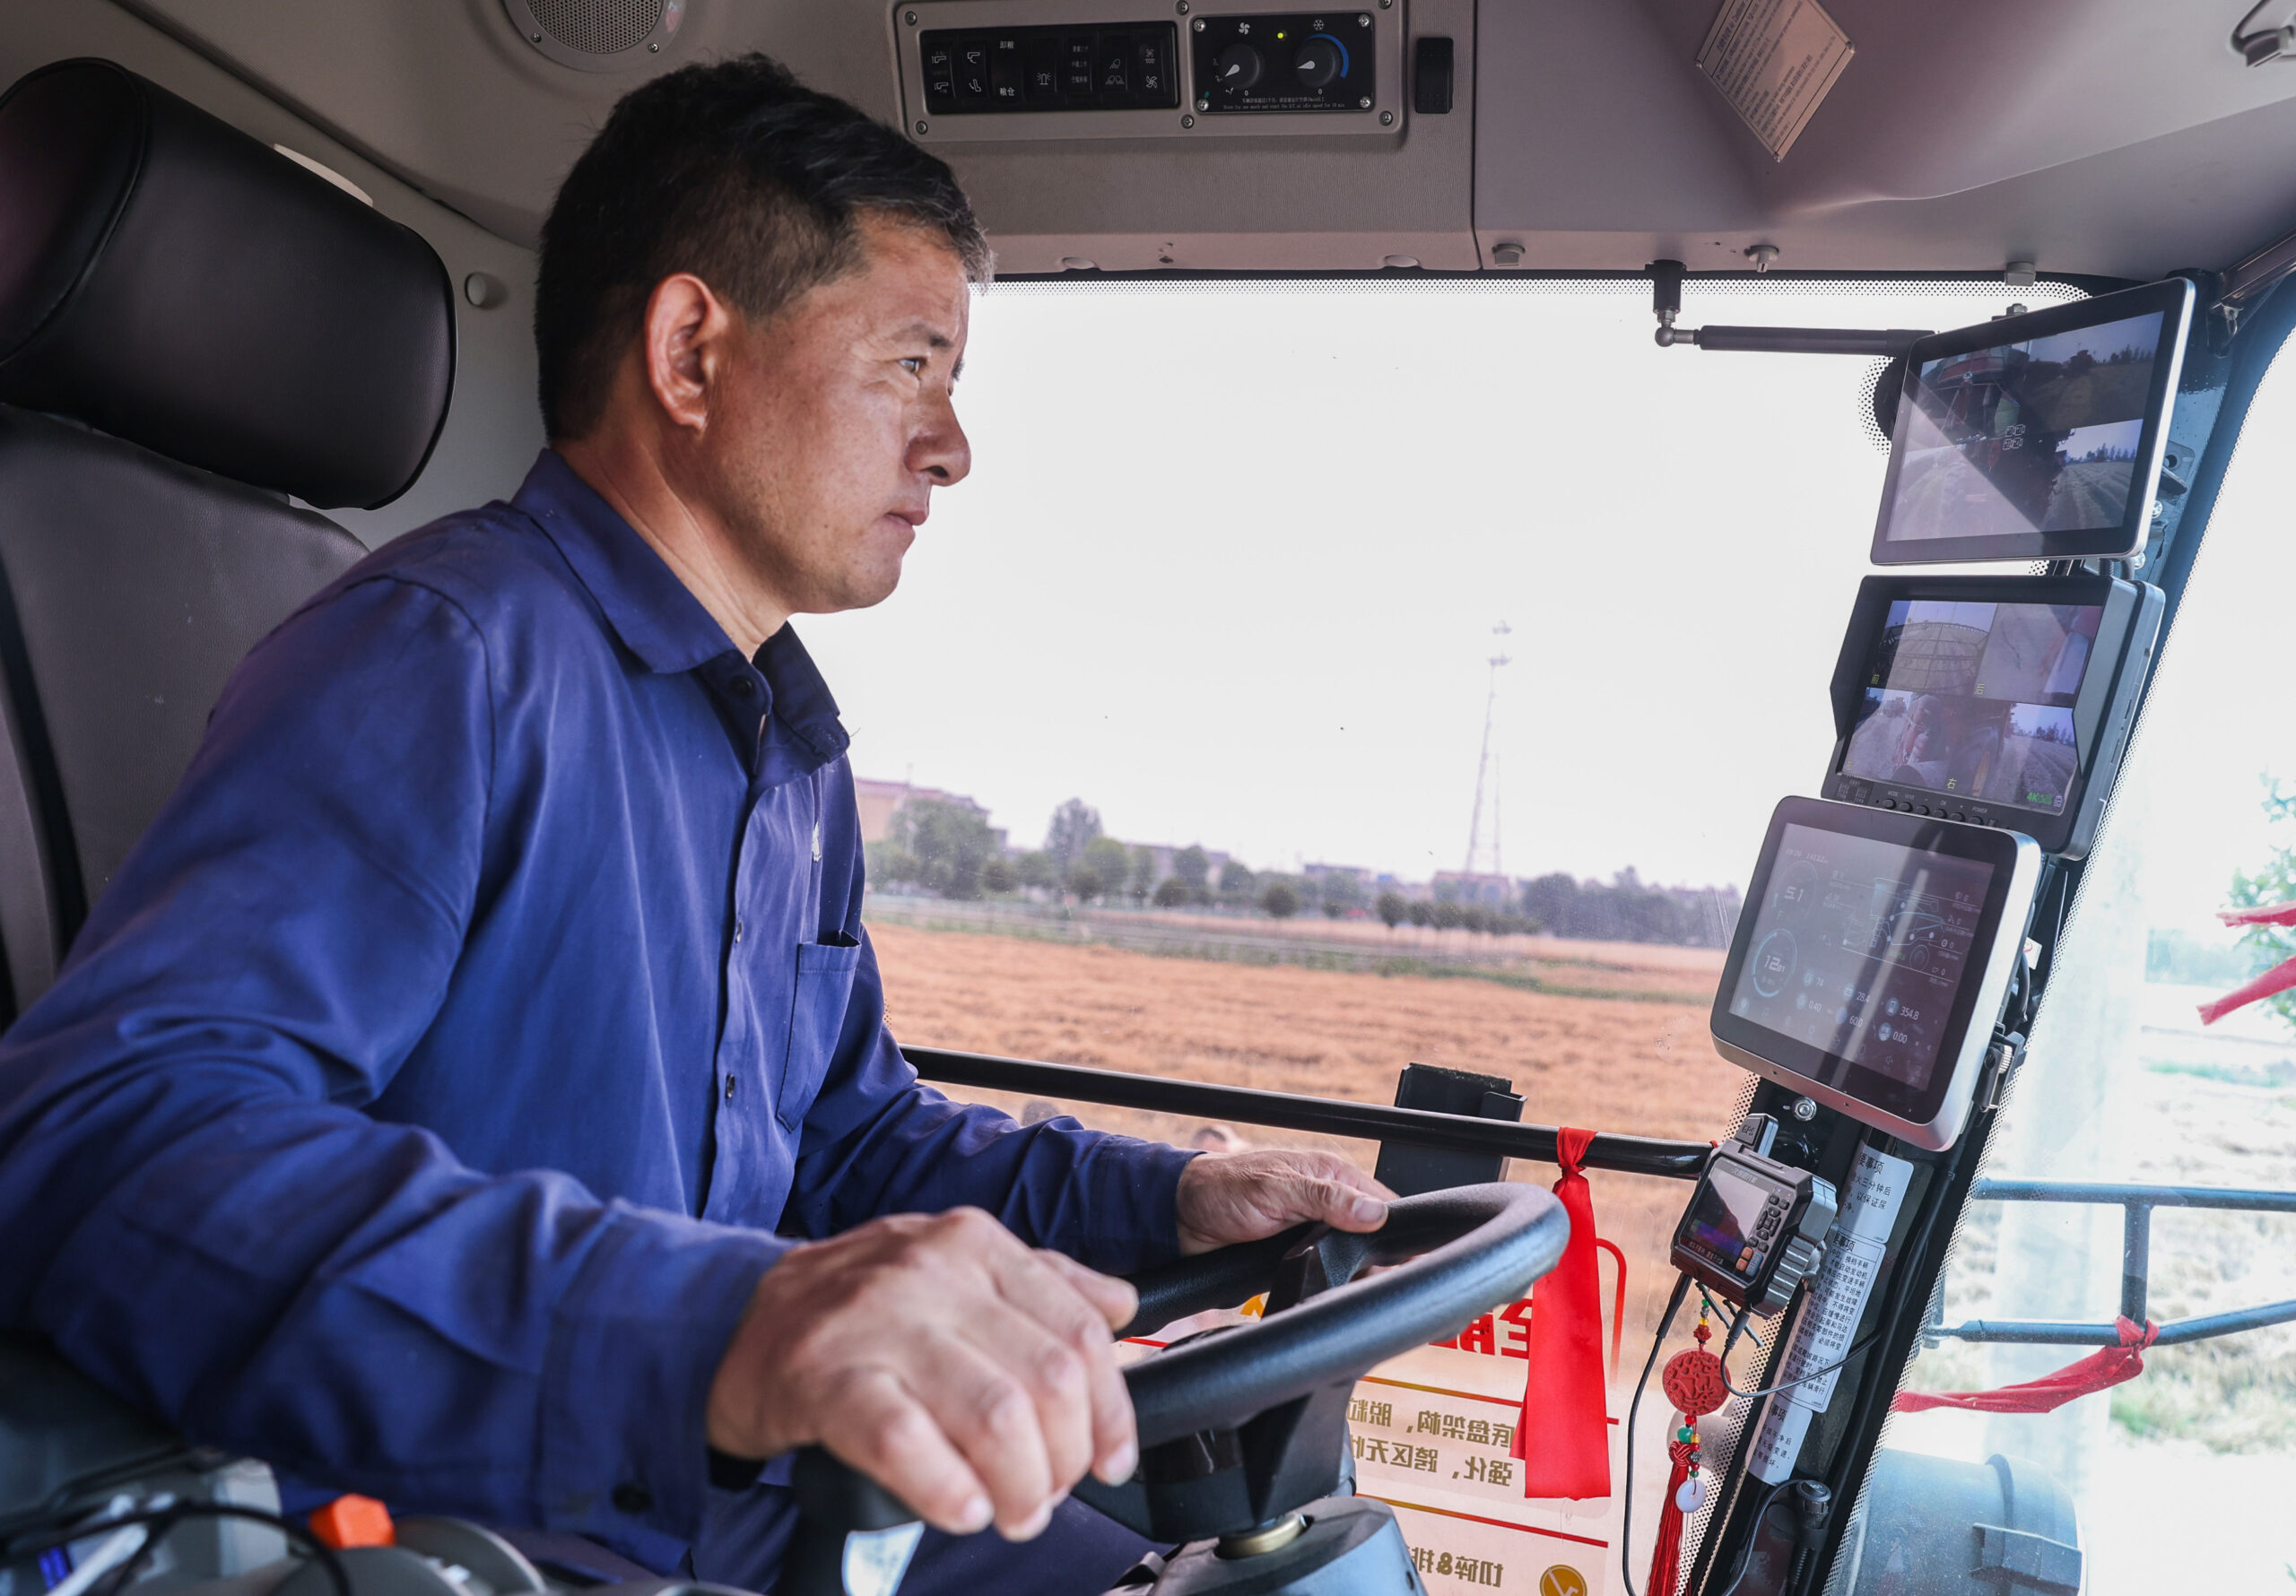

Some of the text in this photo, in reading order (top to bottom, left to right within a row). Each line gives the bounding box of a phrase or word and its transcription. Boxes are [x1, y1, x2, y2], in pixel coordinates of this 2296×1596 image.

[999, 87, 1015, 97] 粮仓
[1976, 683, 1985, 696] 后
[1947, 777, 1957, 790] 右
[2027, 791, 2038, 802] 4K
[1857, 991, 1870, 1003] 28.4
[1900, 1006, 1919, 1020] 354.8
[1849, 1015, 1863, 1028] 60.0
[1893, 1030, 1908, 1044] 0.00
[1852, 1175, 1892, 1197] 火三分钟后
